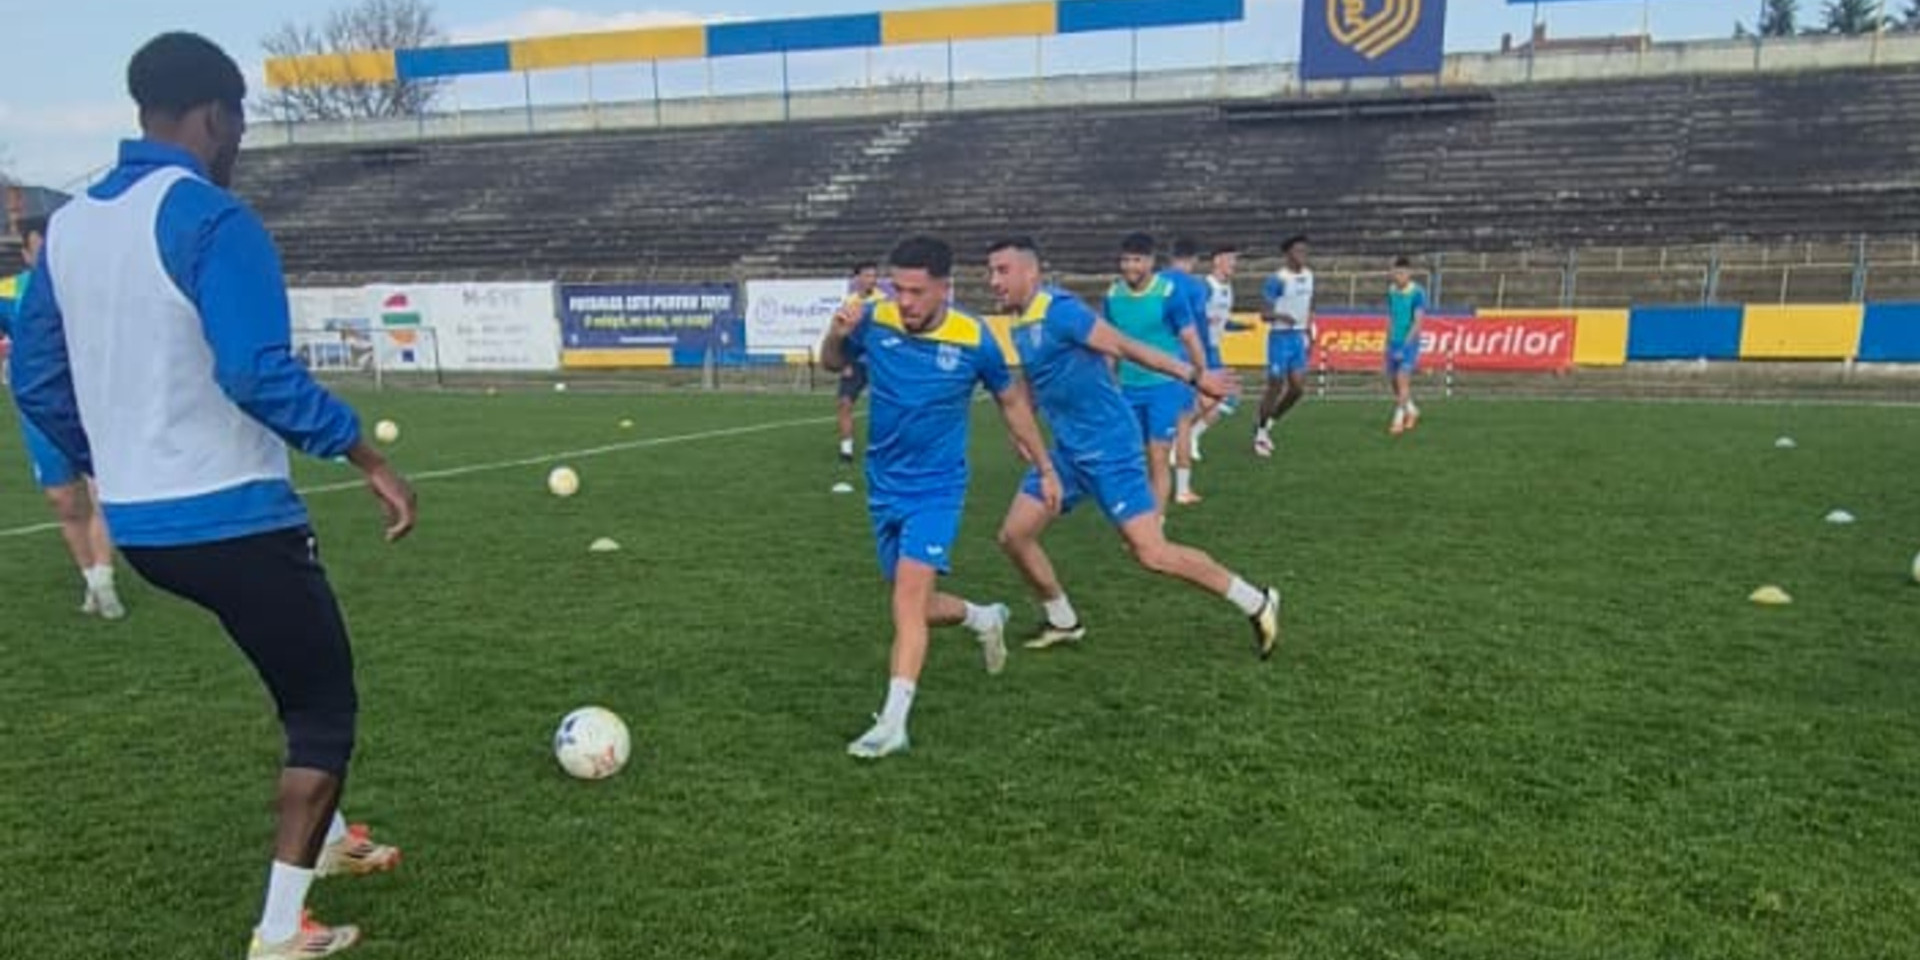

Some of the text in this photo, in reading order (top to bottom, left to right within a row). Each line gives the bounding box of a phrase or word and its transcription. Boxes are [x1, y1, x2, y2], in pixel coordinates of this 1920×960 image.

[626, 295, 650, 310] ESTE
[1320, 325, 1564, 354] casa ariurilor
